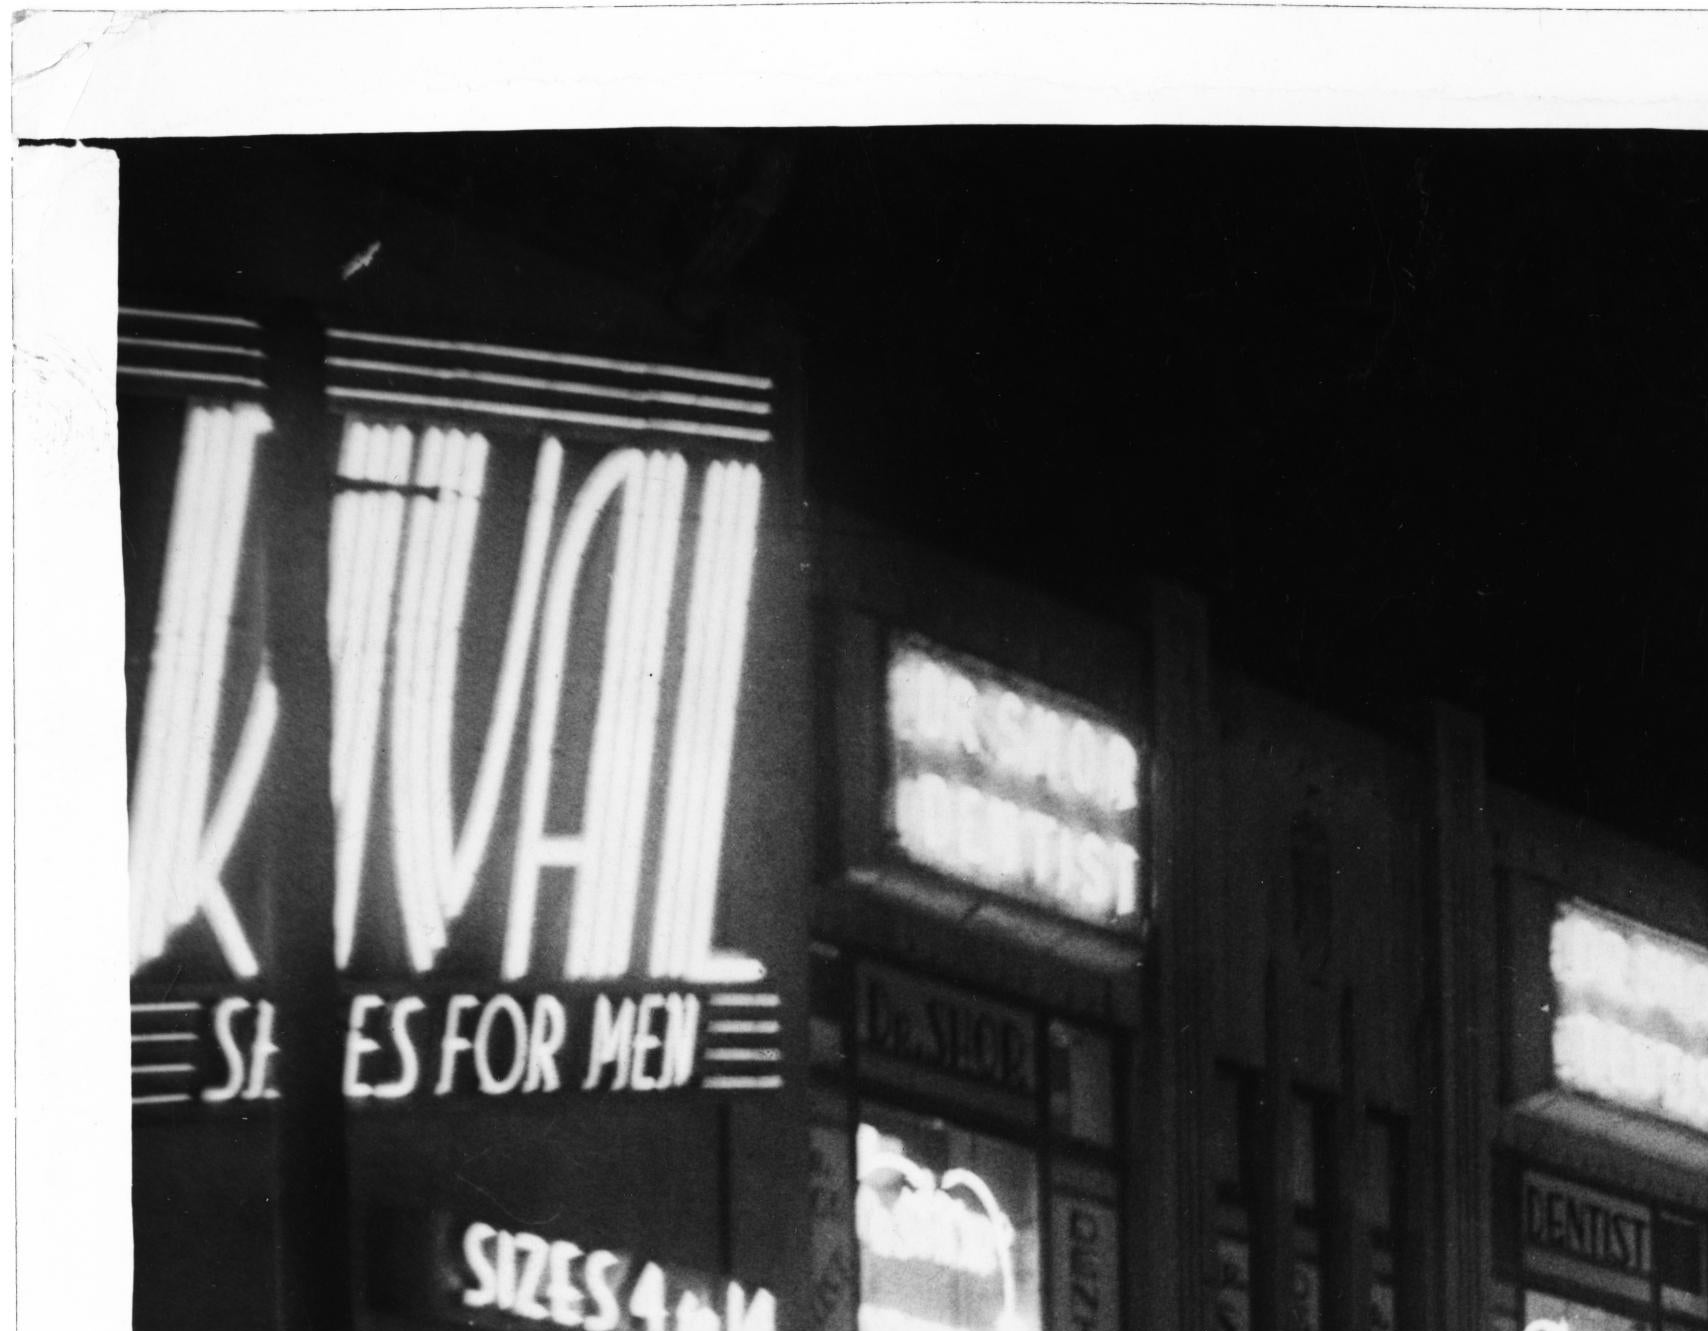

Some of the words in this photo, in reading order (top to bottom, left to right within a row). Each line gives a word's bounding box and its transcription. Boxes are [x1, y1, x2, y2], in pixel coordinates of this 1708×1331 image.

[203, 994, 427, 1102] SES
[436, 994, 566, 1098] FOR
[584, 994, 700, 1092] MEN
[1527, 1185, 1649, 1274] DENTIST
